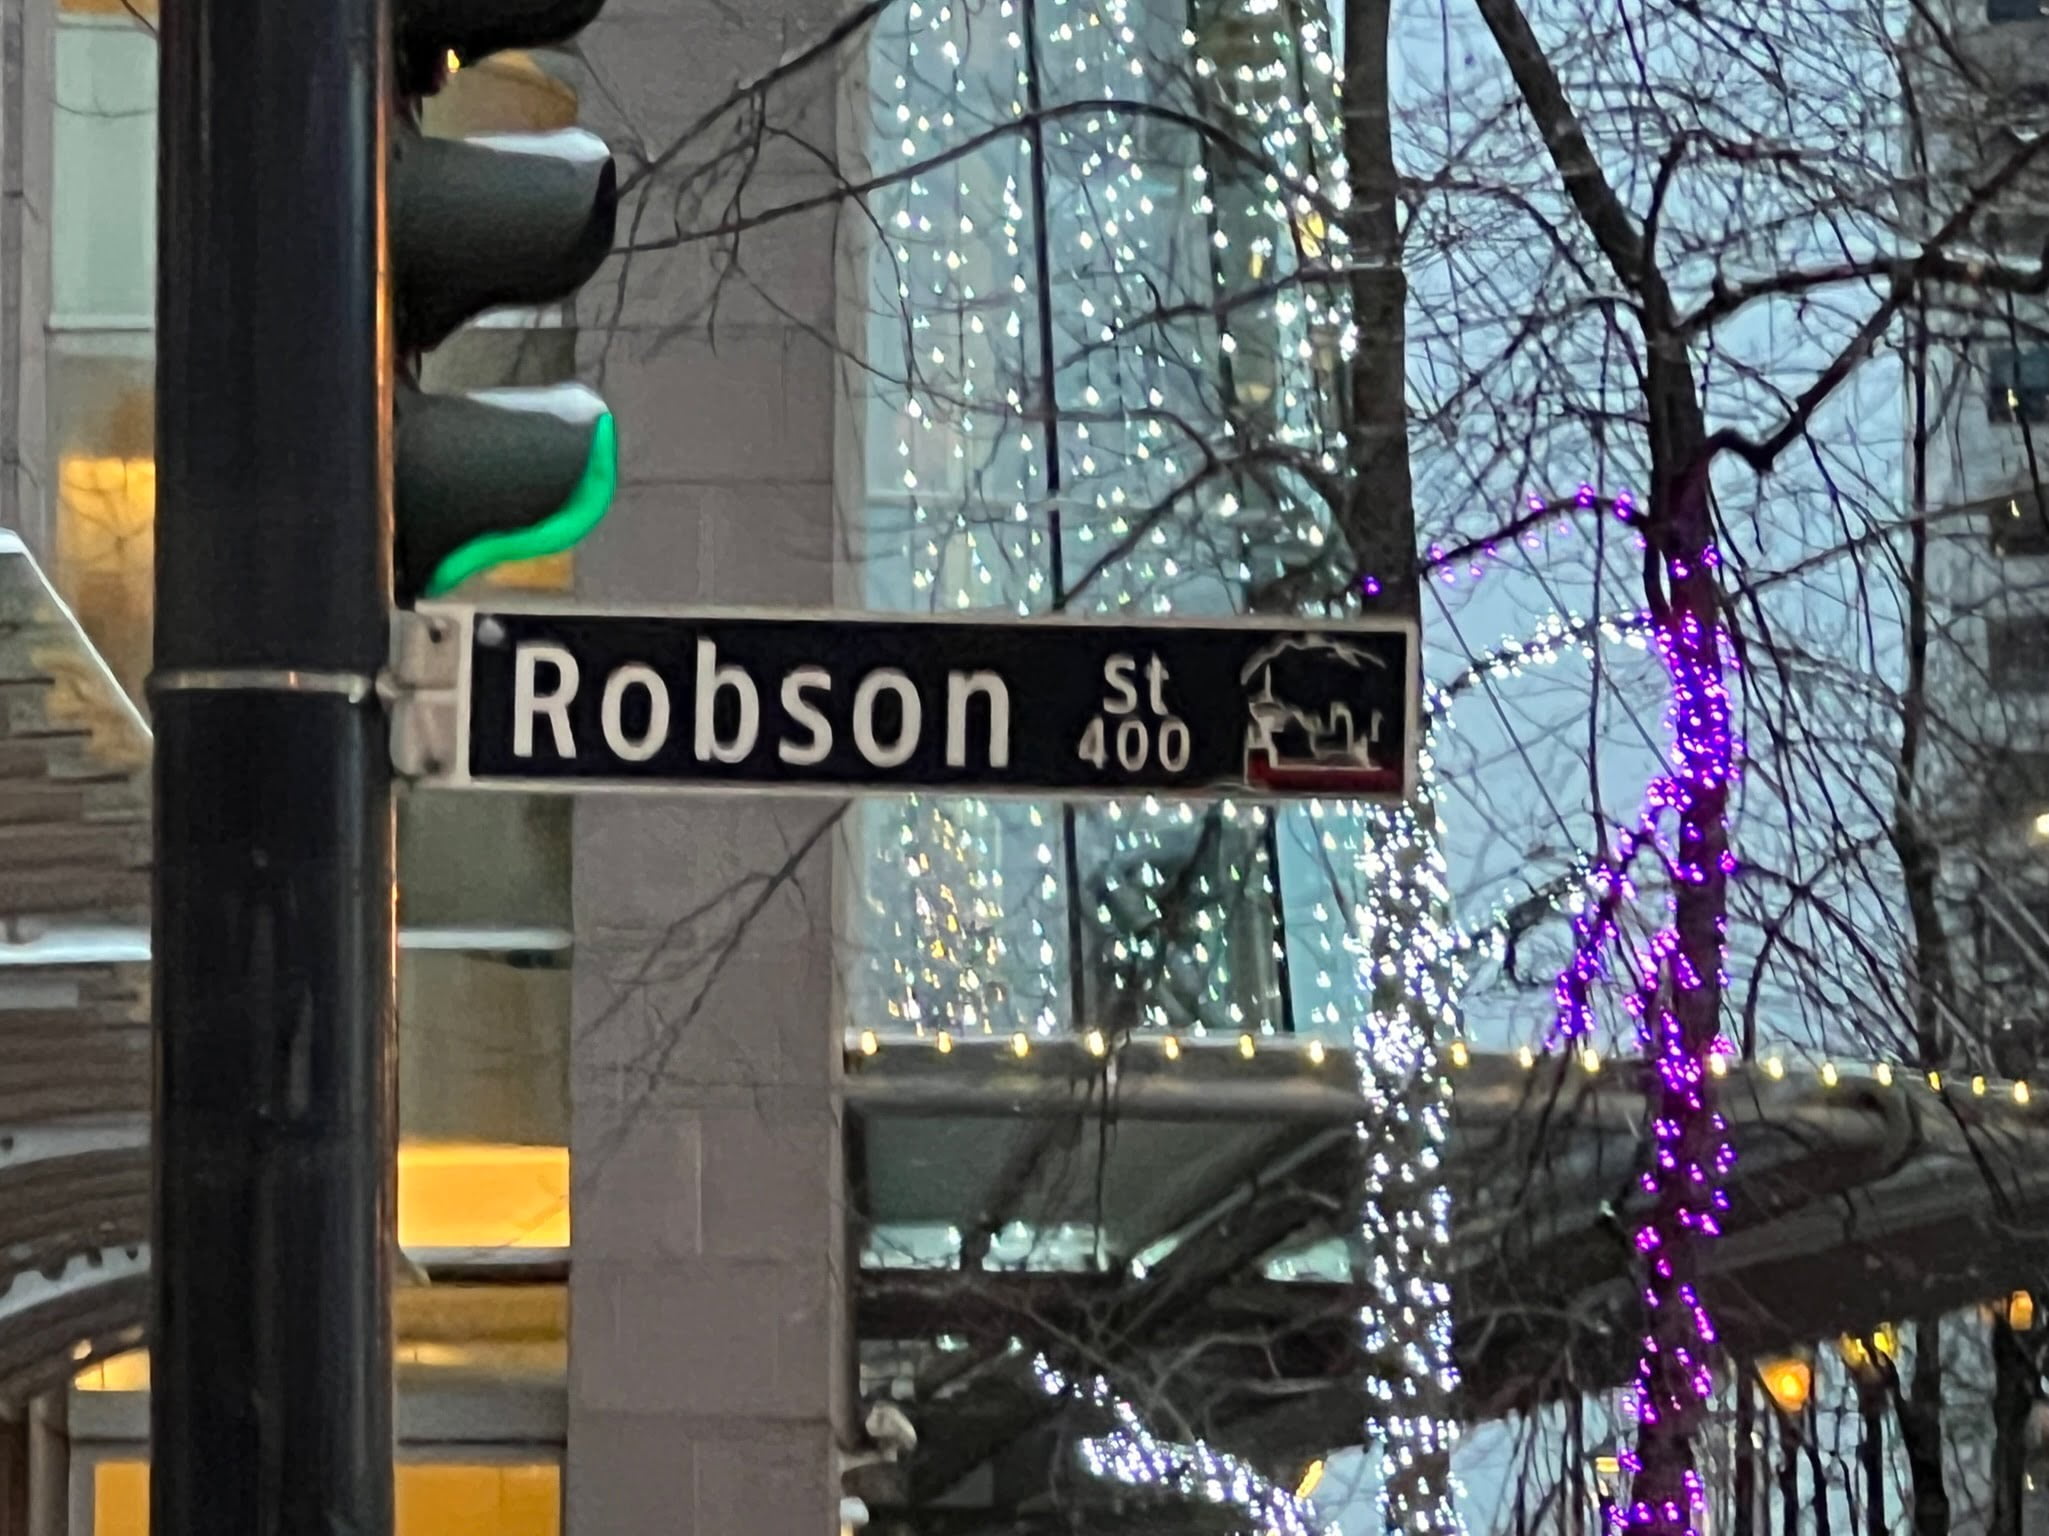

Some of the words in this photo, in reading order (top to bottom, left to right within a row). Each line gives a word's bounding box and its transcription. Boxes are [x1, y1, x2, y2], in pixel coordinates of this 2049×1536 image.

[512, 638, 1010, 766] Robson
[1103, 655, 1169, 716] St
[1077, 717, 1192, 773] 400
